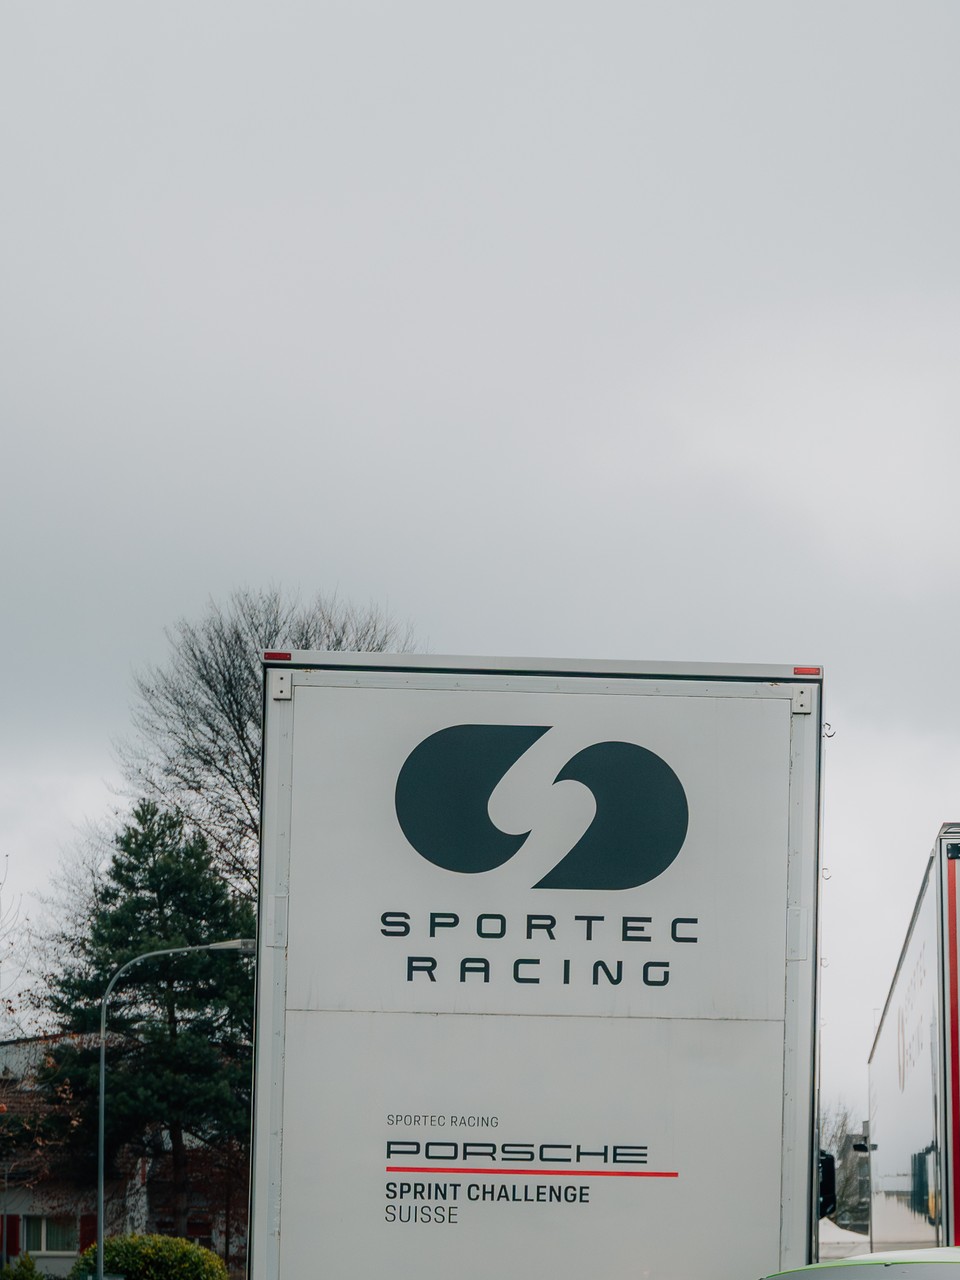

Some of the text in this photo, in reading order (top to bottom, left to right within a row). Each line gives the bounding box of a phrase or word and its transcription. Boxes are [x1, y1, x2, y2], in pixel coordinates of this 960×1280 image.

[380, 911, 699, 944] SPORTEC
[406, 955, 671, 987] RACING
[386, 1114, 499, 1128] SPORTEC RACING
[386, 1141, 648, 1164] PORSCHE
[385, 1182, 590, 1203] SPRINT CHALLENGE
[385, 1204, 459, 1224] SUISSE
